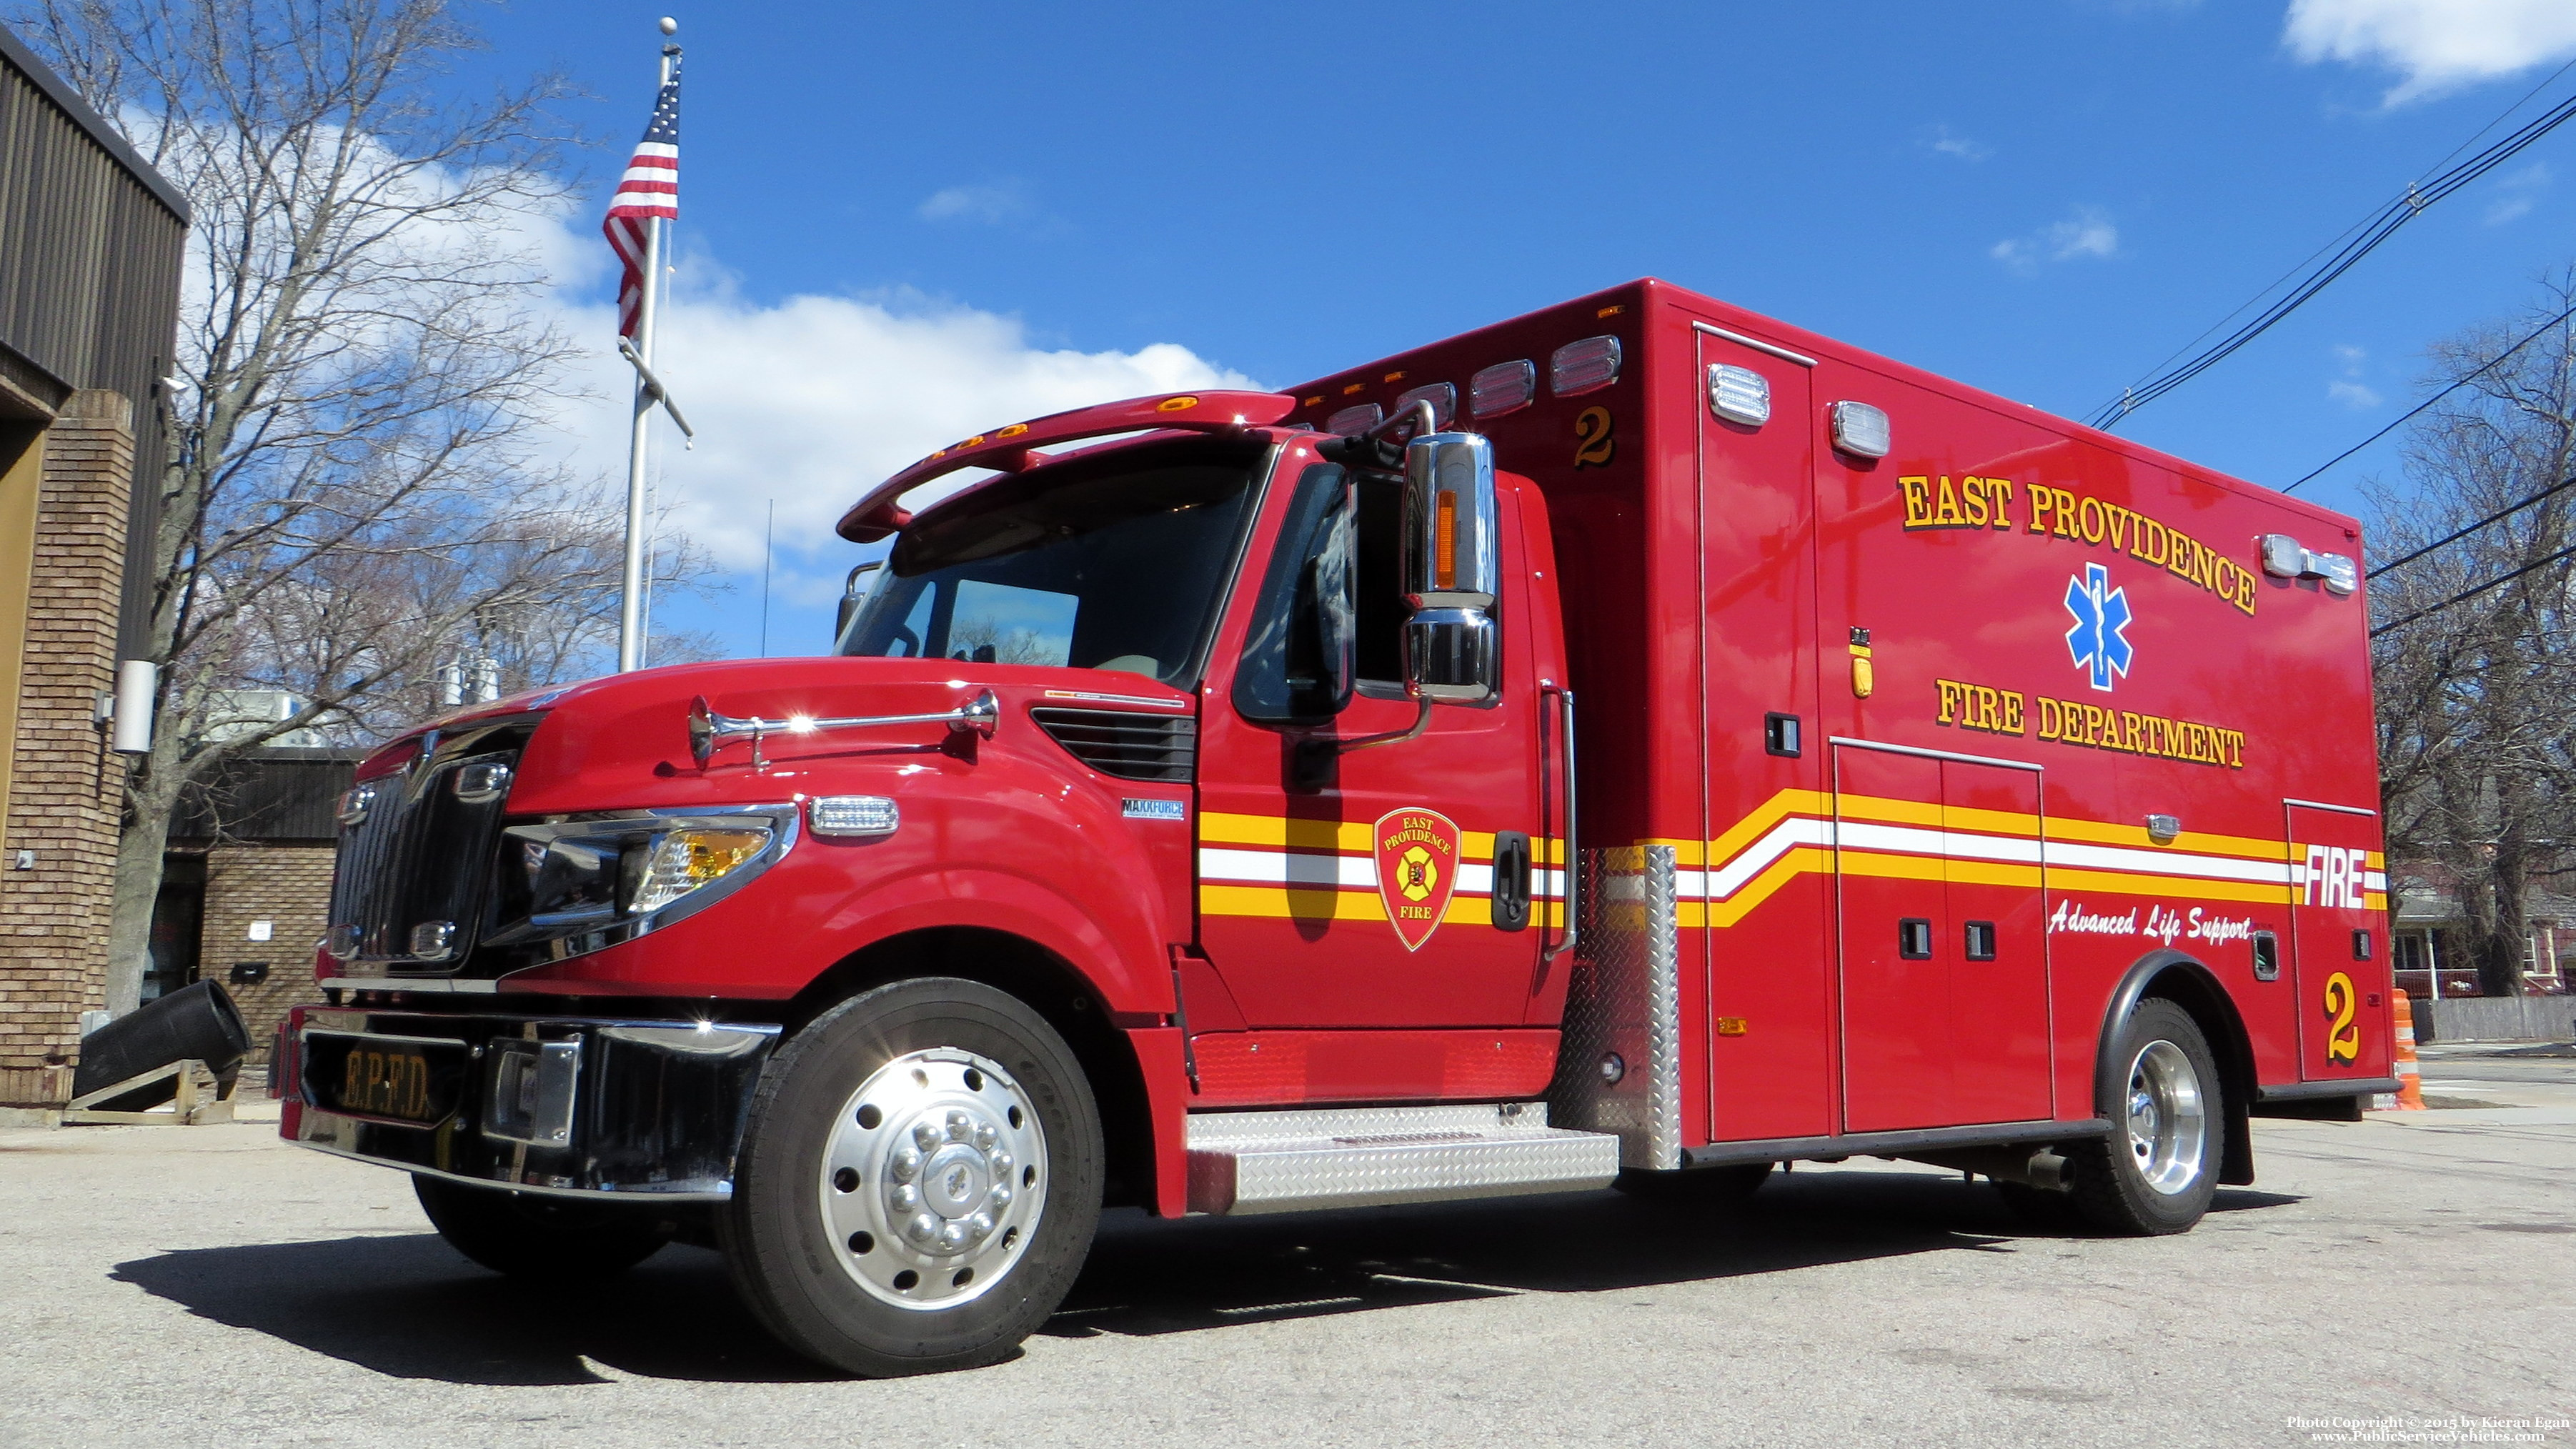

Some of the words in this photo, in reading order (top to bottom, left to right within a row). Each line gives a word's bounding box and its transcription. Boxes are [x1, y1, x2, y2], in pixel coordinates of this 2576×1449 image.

[1574, 405, 1613, 467] 2
[1898, 475, 2012, 528] EAST
[2027, 483, 2257, 616] PROVIDENCE
[1936, 679, 2024, 734] FIRE
[2037, 696, 2244, 767] DEPARTMENT
[1122, 800, 1184, 814] MAXXFORCE
[1403, 817, 1434, 830] EAST
[1384, 830, 1451, 855] PROVIDENCE
[2304, 844, 2366, 910] FIRE
[1400, 906, 1432, 920] FIRE
[2048, 898, 2137, 935] Advanced
[2143, 904, 2181, 946] Life
[2187, 906, 2254, 946] Support
[2325, 971, 2359, 1060] 2
